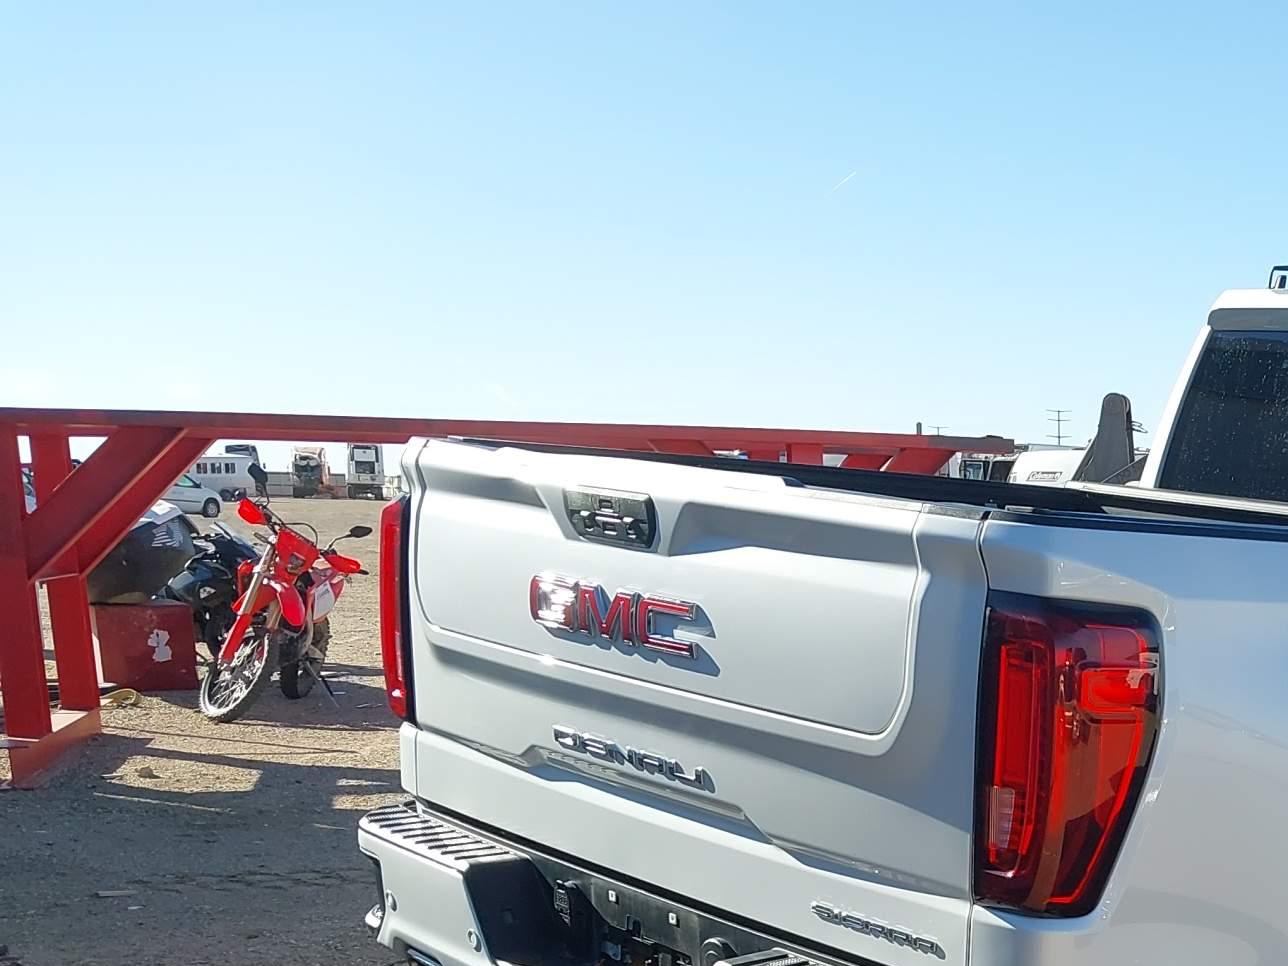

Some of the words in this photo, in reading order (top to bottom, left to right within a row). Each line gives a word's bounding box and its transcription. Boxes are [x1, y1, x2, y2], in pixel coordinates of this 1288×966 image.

[529, 573, 697, 658] GMC
[552, 725, 711, 788] DENALI
[810, 901, 945, 957] SIERRA
